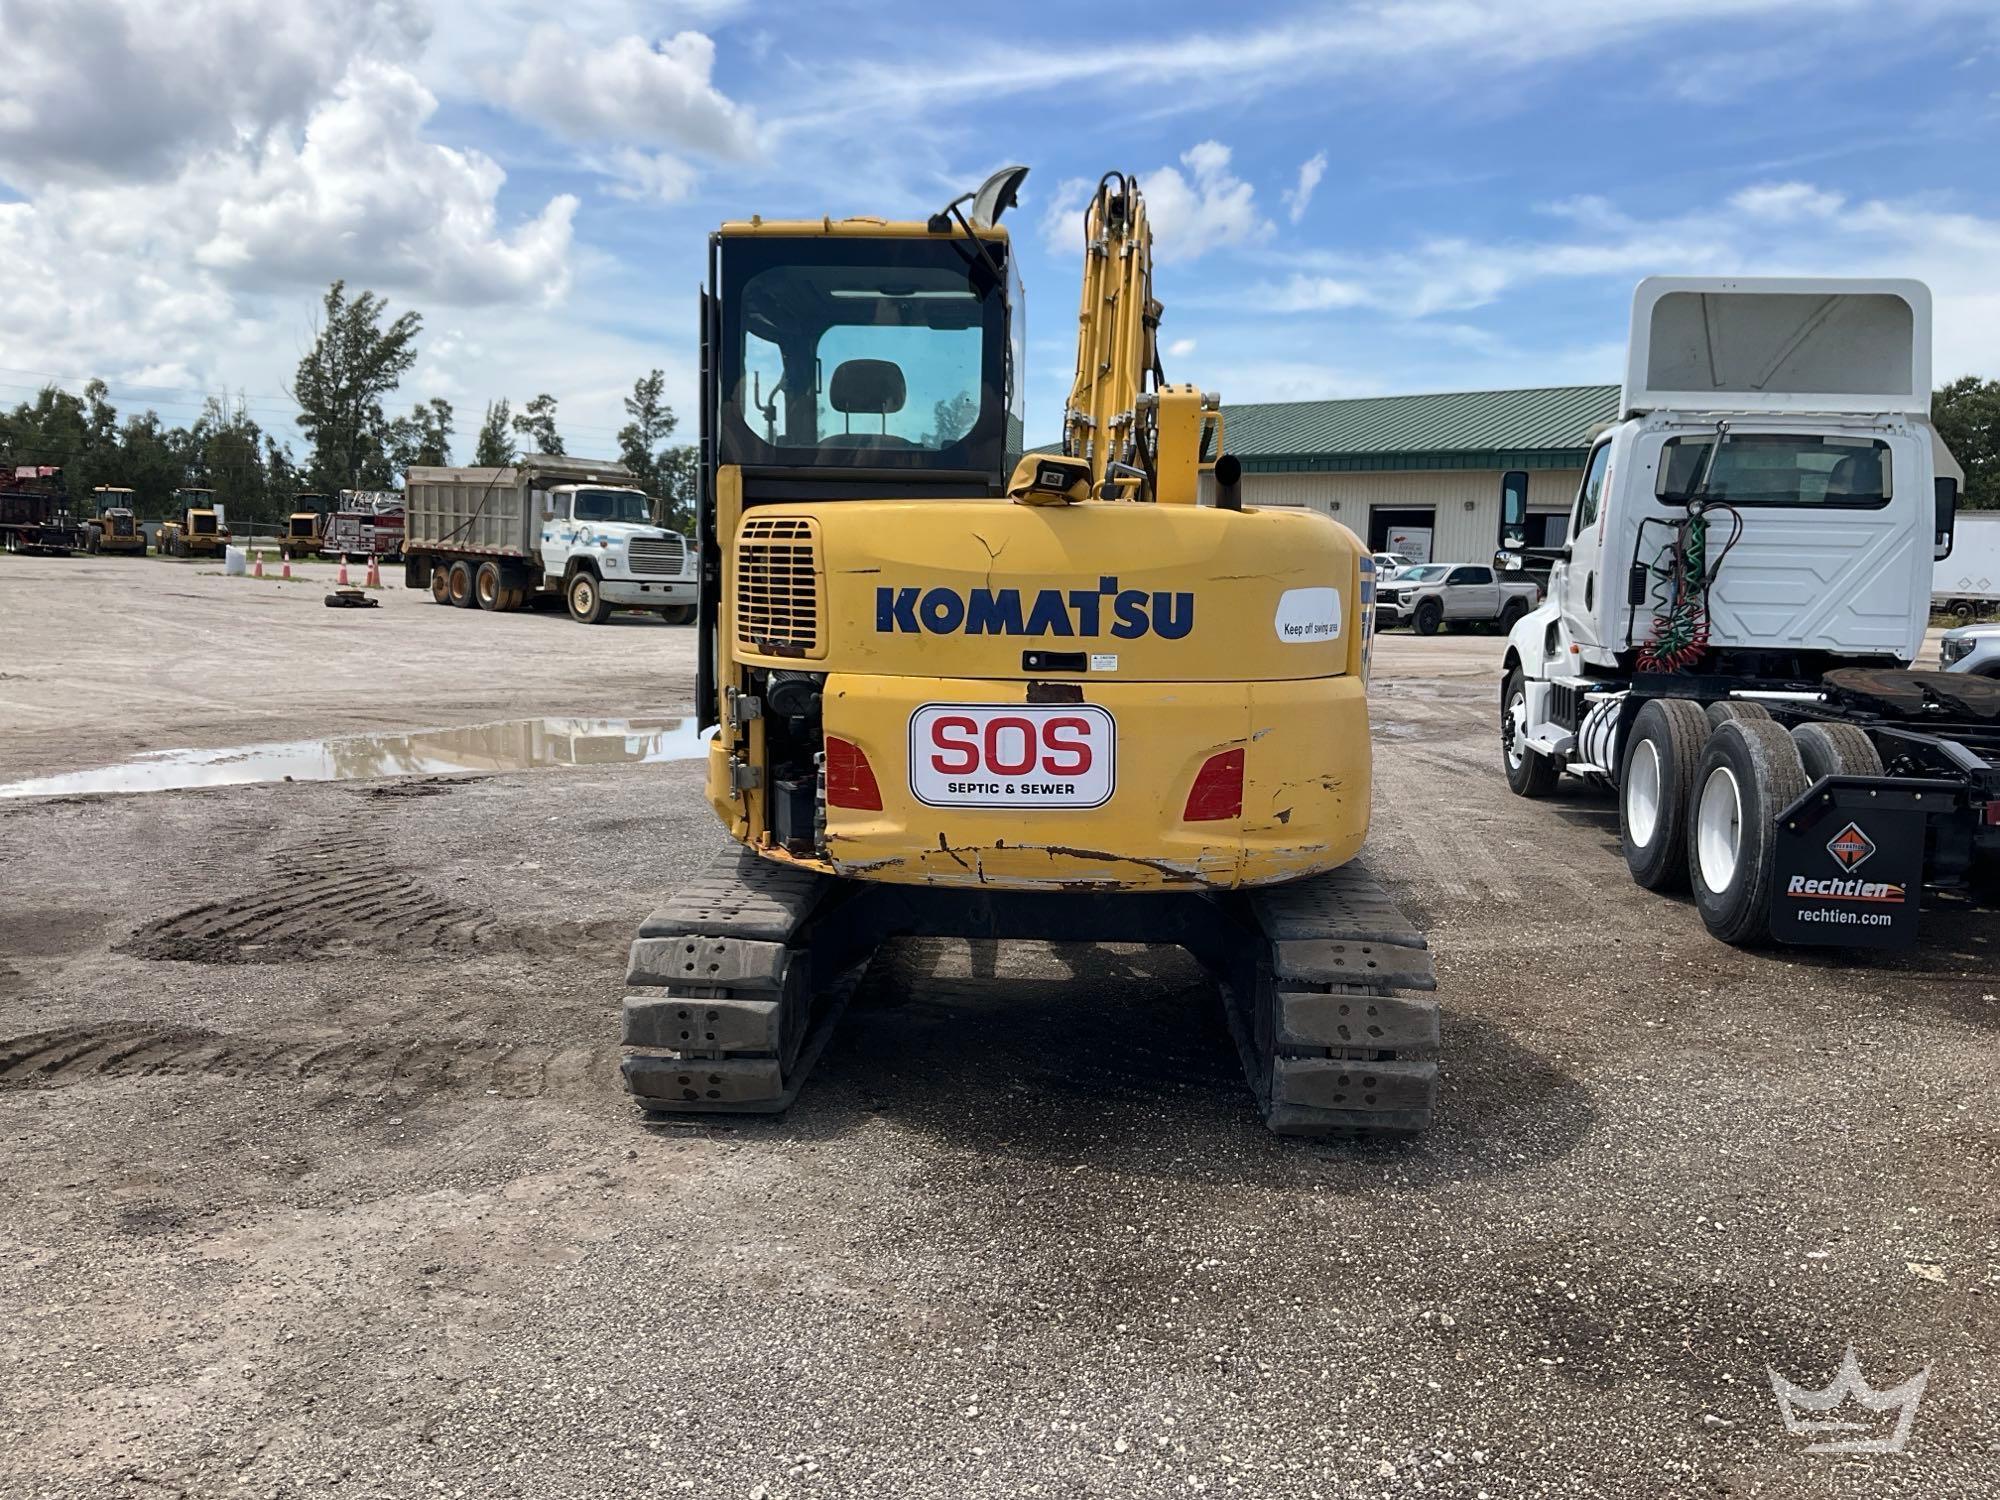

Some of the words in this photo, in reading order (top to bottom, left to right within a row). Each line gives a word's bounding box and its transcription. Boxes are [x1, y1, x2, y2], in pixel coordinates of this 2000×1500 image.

[876, 576, 1194, 640] KOMATSU
[1284, 623, 1303, 636] Keep
[1305, 622, 1313, 634] off
[1314, 622, 1328, 635] swing
[931, 716, 1093, 776] SOS
[948, 782, 999, 794] SEPTIC
[1005, 783, 1015, 794] &
[1020, 783, 1075, 795] SEWER
[1787, 875, 1889, 898] Rechtien
[1797, 908, 1892, 926] rechtien.com
